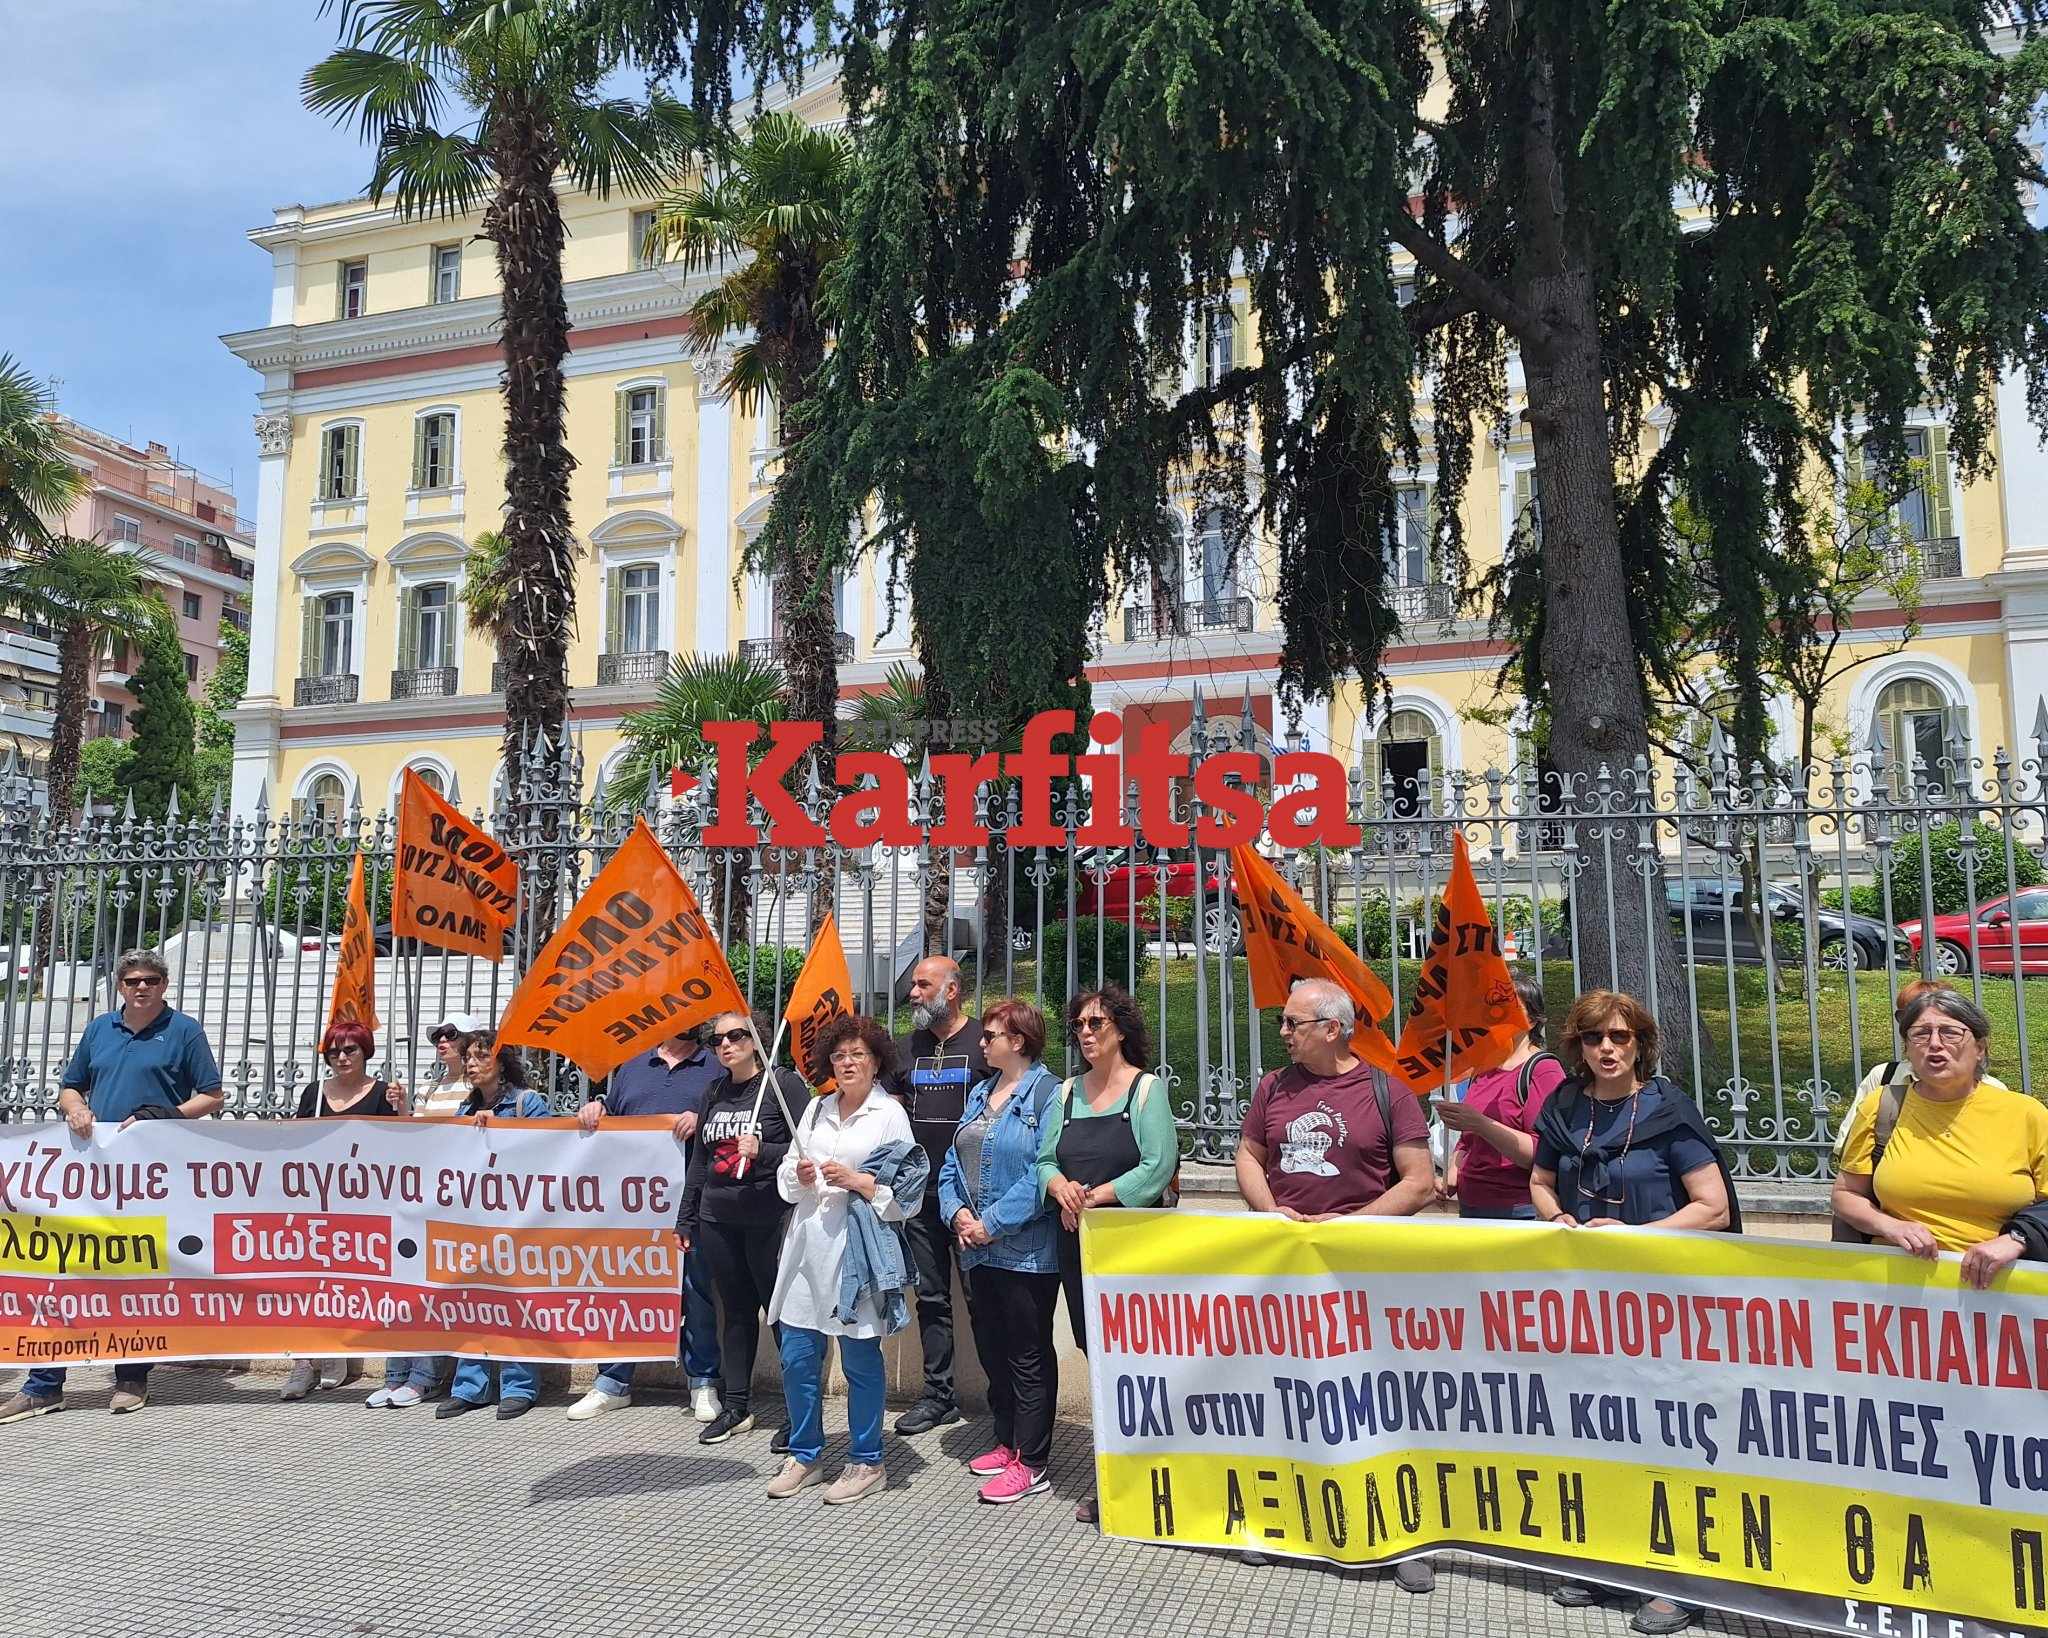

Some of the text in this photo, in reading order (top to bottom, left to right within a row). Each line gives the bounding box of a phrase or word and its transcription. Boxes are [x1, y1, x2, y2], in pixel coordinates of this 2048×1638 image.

[416, 904, 487, 944] ΟΛΜΕ
[0, 1140, 671, 1214] χίζουμε τον αγώνα ενάντια σε
[1, 1213, 673, 1287] λόγηση διώξεις πειθαρχικά
[0, 1280, 676, 1341] α χέρια από την συνάδελφο Χρύσα Χοτζόγλου
[16, 1331, 100, 1360] Επιτροπή
[106, 1329, 169, 1358] Αγώνα
[1100, 1290, 1373, 1360] ΜΟΝΙΜΟΠΟΙΗΣΗ
[1384, 1306, 1465, 1351] των
[1480, 1288, 1814, 1369] ΝΕΟΔΙΟΡΙΣΤΩΝ
[1117, 1370, 2048, 1506] ΟΧΙ στην ΤΡΟΜΟΚΡΑΤΙΑ και τις ΑΠΕΙΛΕΣ για
[1151, 1467, 1175, 1537] Η
[1225, 1461, 1587, 1549] ΑΞΙΟΛΟΓΗΣΗ
[1649, 1479, 1773, 1573] ΔΕΝ
[1844, 1503, 1934, 1592] ΘΑ
